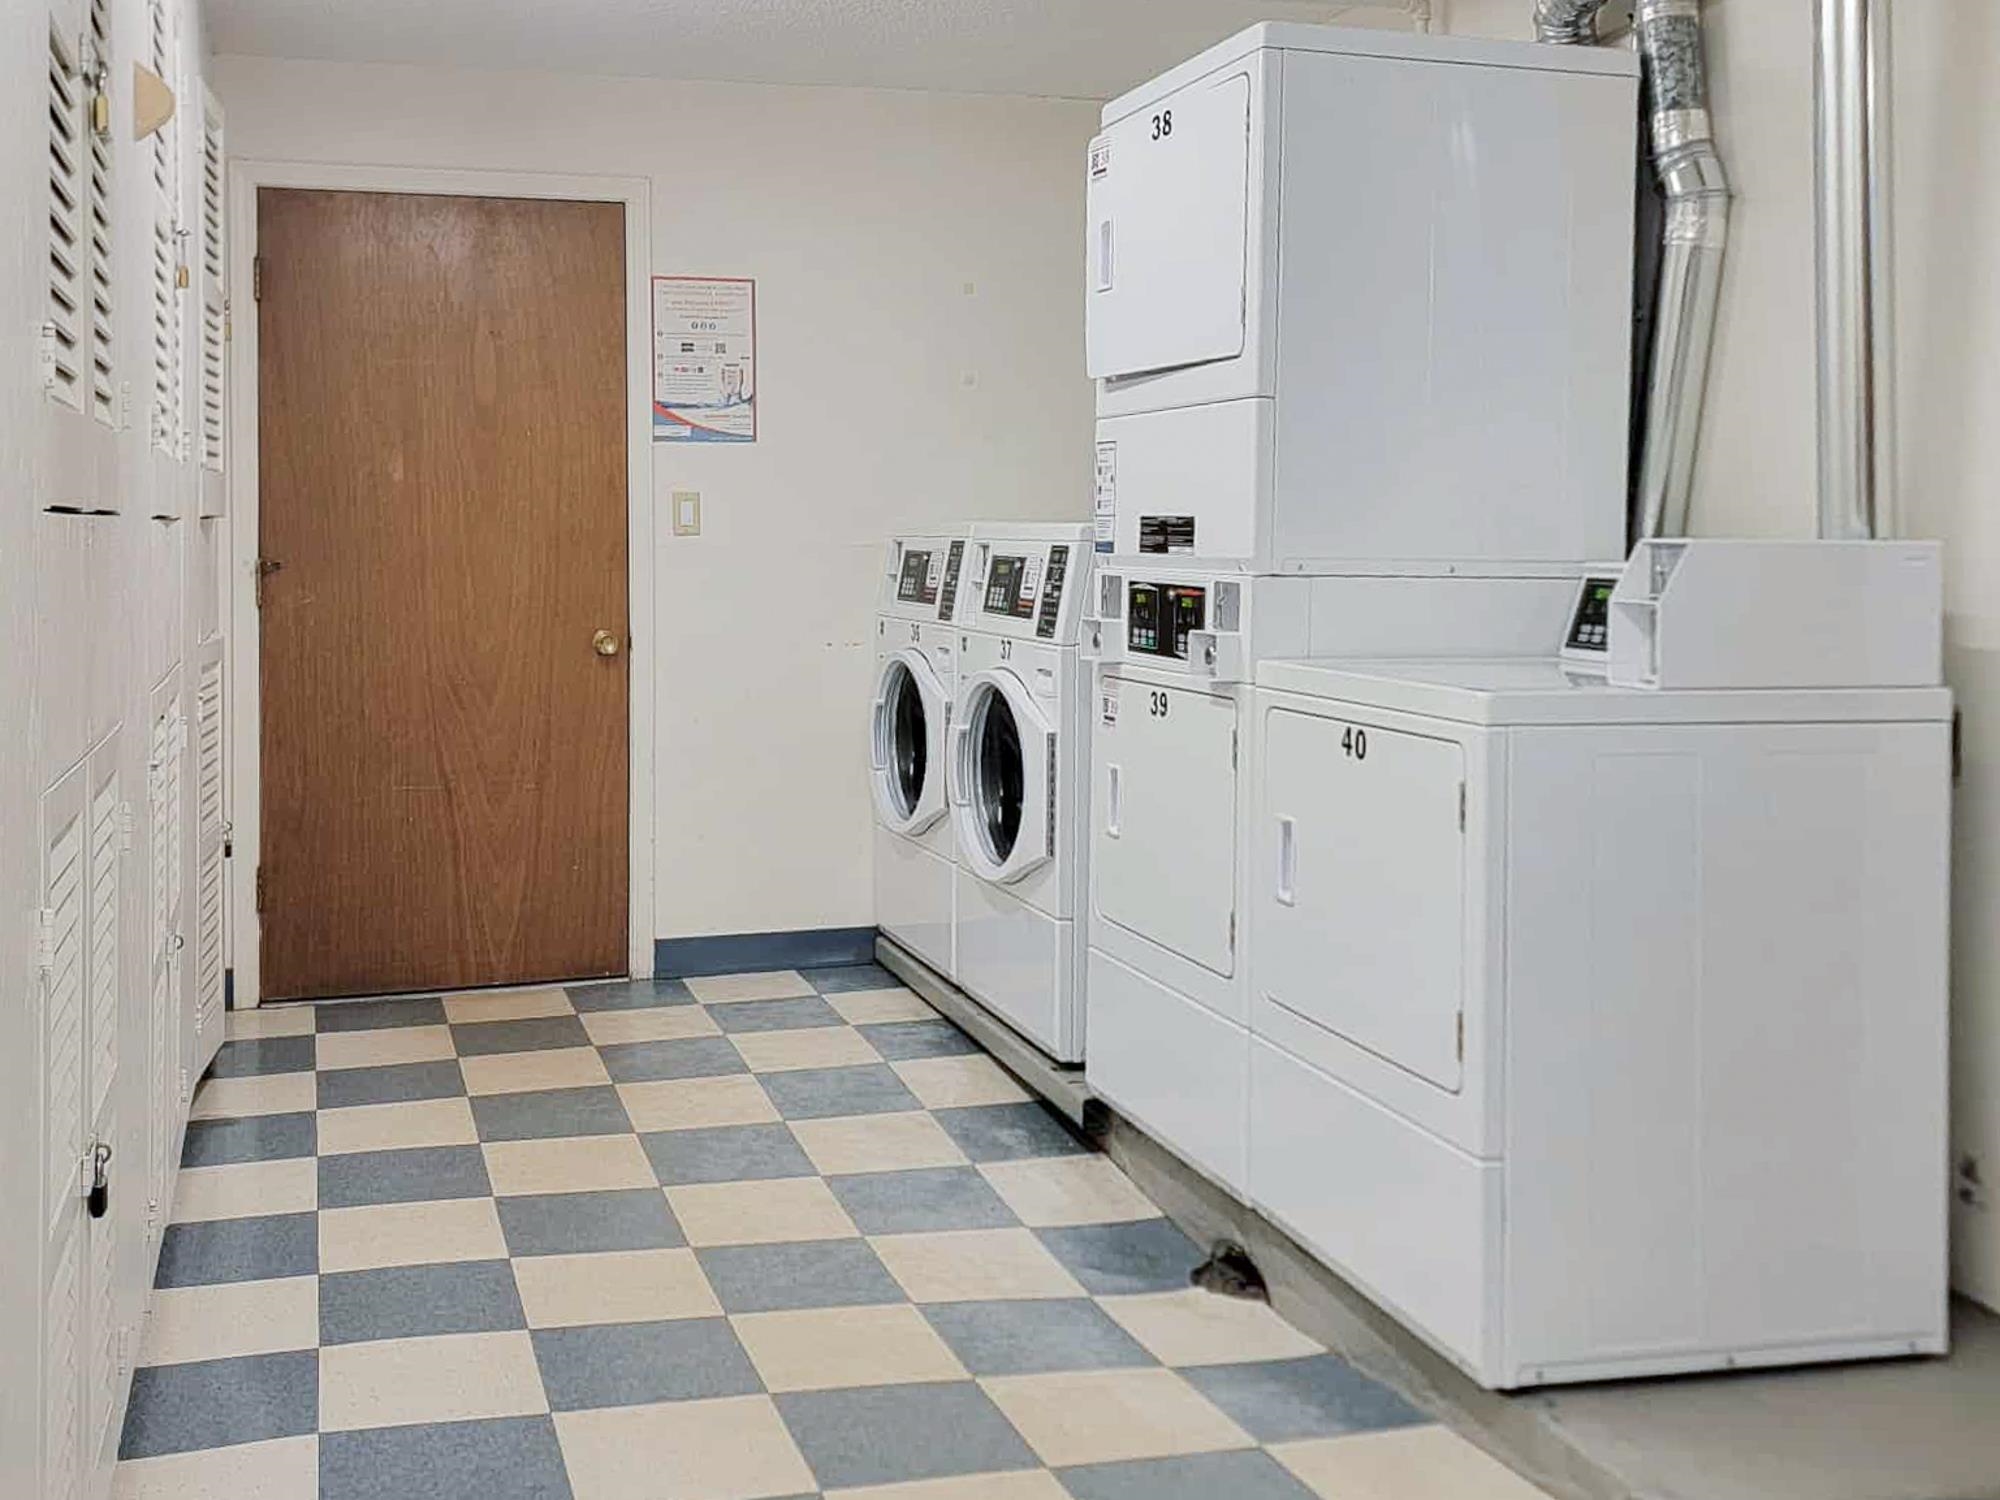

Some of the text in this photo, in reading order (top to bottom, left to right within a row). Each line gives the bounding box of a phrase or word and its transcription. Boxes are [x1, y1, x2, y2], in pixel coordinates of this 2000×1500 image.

[1152, 110, 1172, 140] 38
[1001, 639, 1013, 660] 37
[1151, 691, 1169, 717] 39
[1341, 726, 1368, 760] 40
